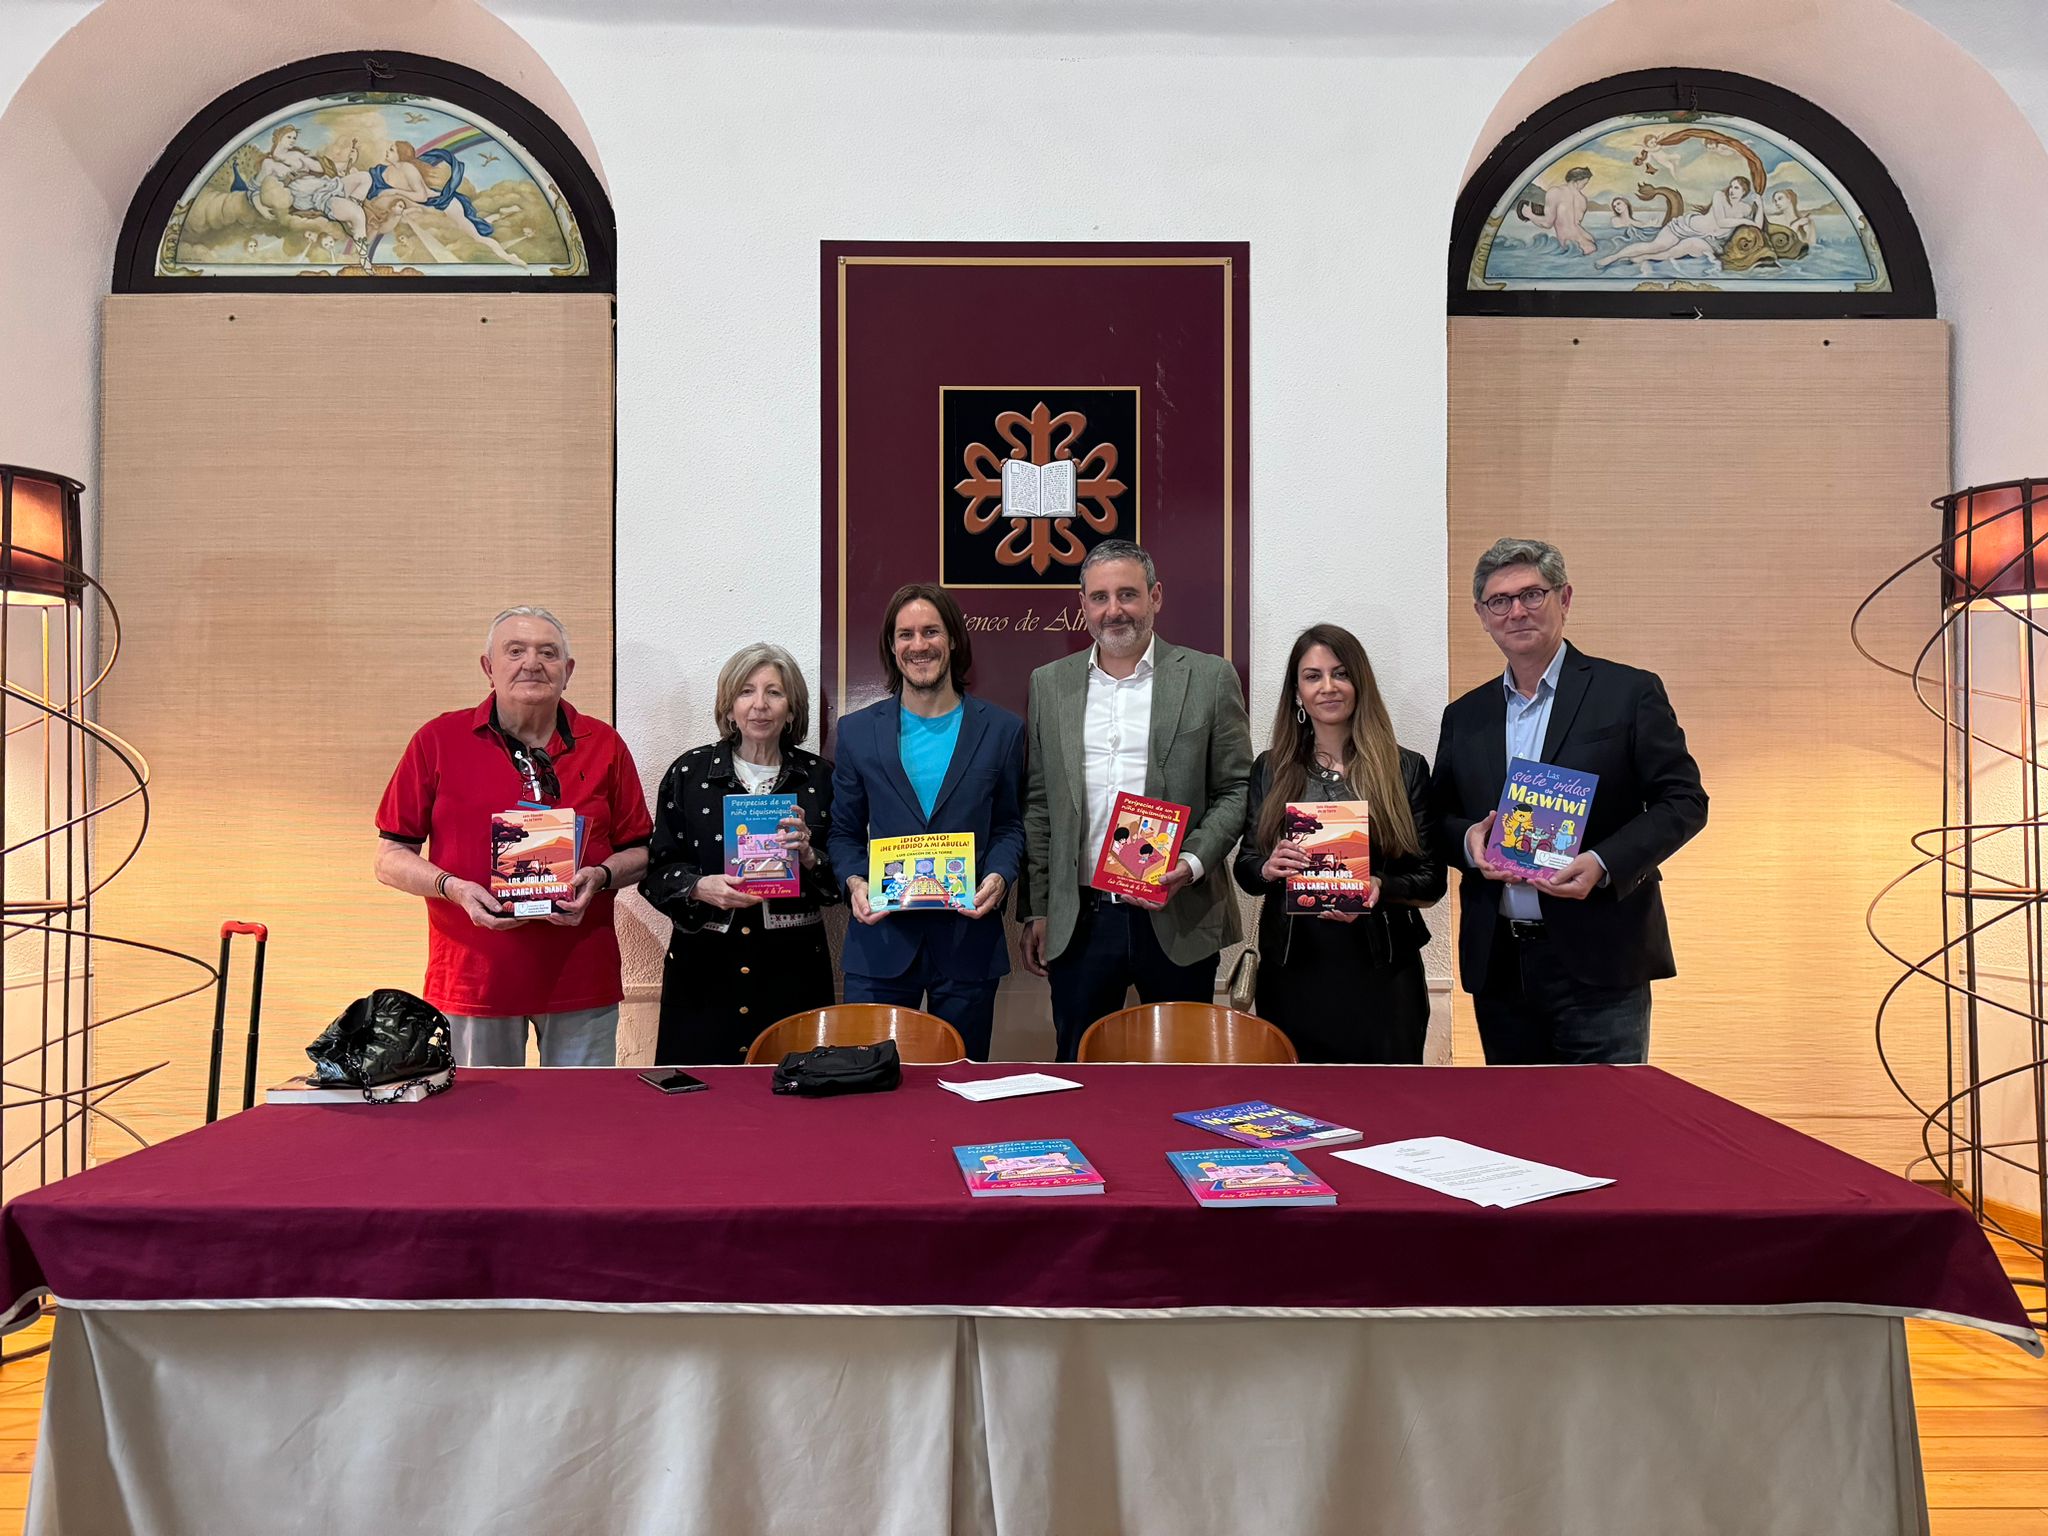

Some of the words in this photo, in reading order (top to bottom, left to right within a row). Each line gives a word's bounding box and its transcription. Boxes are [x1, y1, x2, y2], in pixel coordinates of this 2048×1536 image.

[963, 613, 1010, 631] eneo
[1014, 608, 1040, 632] de
[1546, 770, 1560, 780] Las
[1512, 770, 1547, 787] siete
[1553, 779, 1591, 797] vidas
[731, 799, 768, 809] Peripecias
[769, 798, 780, 806] de
[1507, 783, 1587, 817] Mawiwi
[730, 808, 748, 817] niño
[1121, 804, 1136, 812] niño
[1124, 798, 1154, 810] Peripecias
[1172, 810, 1181, 823] 1
[893, 842, 923, 851] PERDIDO
[941, 840, 970, 848] ABUELA!
[508, 877, 520, 885] LOS
[522, 874, 558, 885] JUBILADOS
[1303, 870, 1316, 879] LOS
[497, 888, 510, 898] LOS
[511, 887, 534, 897] CARGA
[535, 886, 544, 895] EL
[544, 884, 568, 894] DIABLO
[1293, 882, 1306, 891] LOS
[1306, 882, 1330, 891] CARGA
[1331, 882, 1339, 891] EL
[1340, 882, 1365, 891] DIABLO
